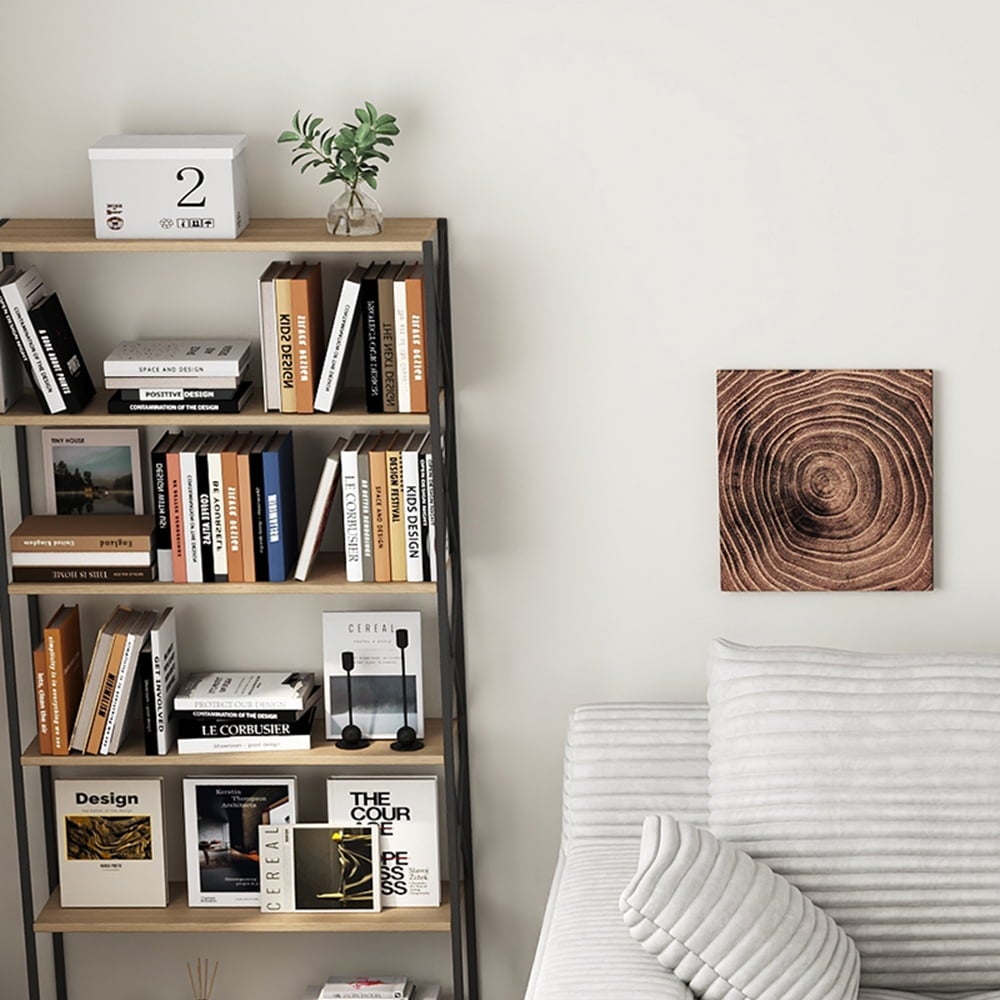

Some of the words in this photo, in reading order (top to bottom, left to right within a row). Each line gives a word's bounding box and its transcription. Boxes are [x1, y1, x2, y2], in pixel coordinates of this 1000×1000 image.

[176, 166, 206, 207] 2
[344, 476, 356, 490] LE
[390, 456, 398, 486] DESIGN
[391, 488, 400, 523] FESTIVAL
[406, 486, 417, 512] KIDS
[345, 492, 359, 562] CORBUSIER
[408, 515, 420, 559] DESIGN
[348, 624, 394, 633] CEREAL
[156, 680, 164, 732] INVOLVED
[202, 725, 218, 736] LE
[219, 724, 290, 736] CORBUSIER
[76, 792, 139, 808] Design
[350, 792, 390, 806] THE
[350, 807, 411, 821] COUR
[264, 827, 281, 911] CEREAL
